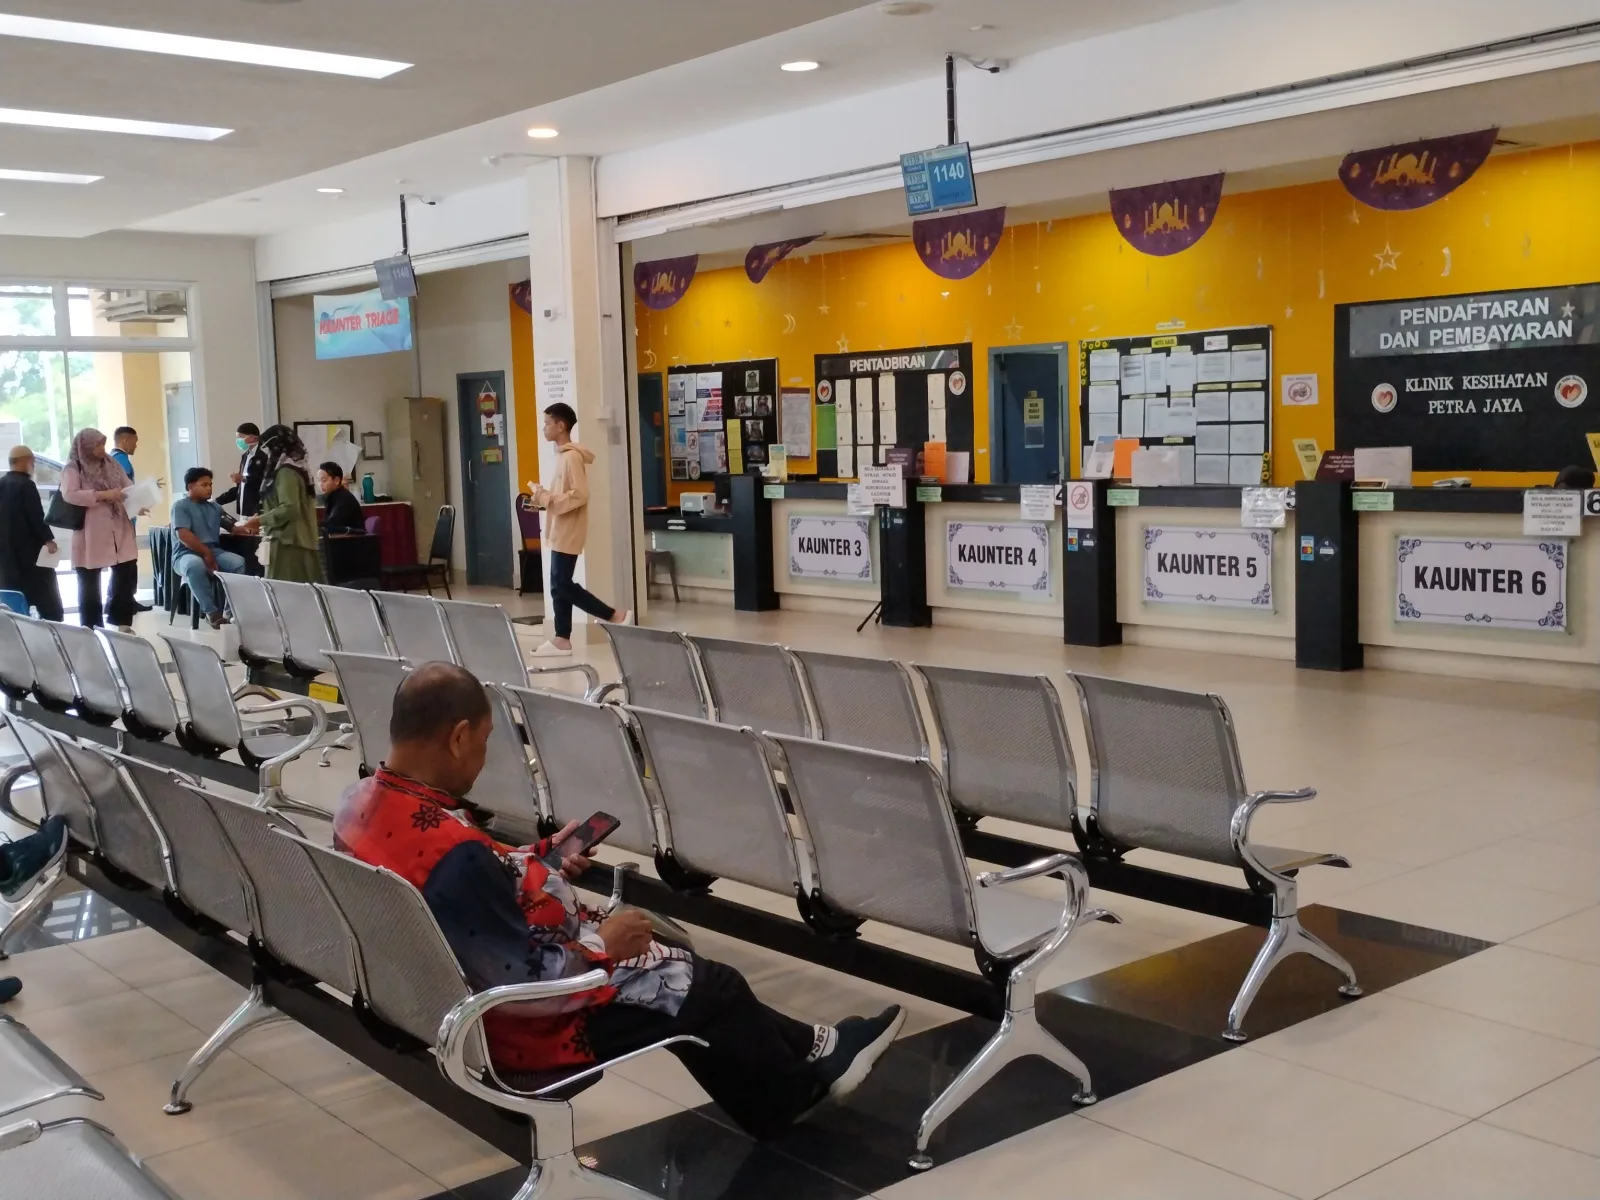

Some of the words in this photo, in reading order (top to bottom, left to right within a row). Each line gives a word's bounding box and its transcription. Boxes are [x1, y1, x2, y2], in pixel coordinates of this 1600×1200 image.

[934, 162, 965, 182] 1140
[319, 315, 361, 334] KAUNTER
[364, 307, 399, 327] TRIAGE
[1400, 297, 1550, 326] PENDAFTARAN
[1379, 330, 1419, 349] DAN
[1429, 319, 1573, 346] PEMBAYARAN
[849, 355, 926, 373] PENTADBIRAN
[1405, 376, 1454, 392] KLINIK
[1462, 372, 1548, 390] KESIHATAN
[1428, 399, 1477, 414] PETRA
[1482, 398, 1523, 413] JAYA
[1587, 491, 1600, 514] 6
[798, 537, 851, 556] KAUNTER
[854, 540, 862, 557] 3
[958, 544, 1023, 565] KAUNTER
[1027, 548, 1037, 566] 4
[1157, 552, 1240, 577] KAUNTER
[1246, 557, 1257, 578] 5
[1414, 565, 1523, 594] KAUNTER
[1531, 571, 1547, 596] 6
